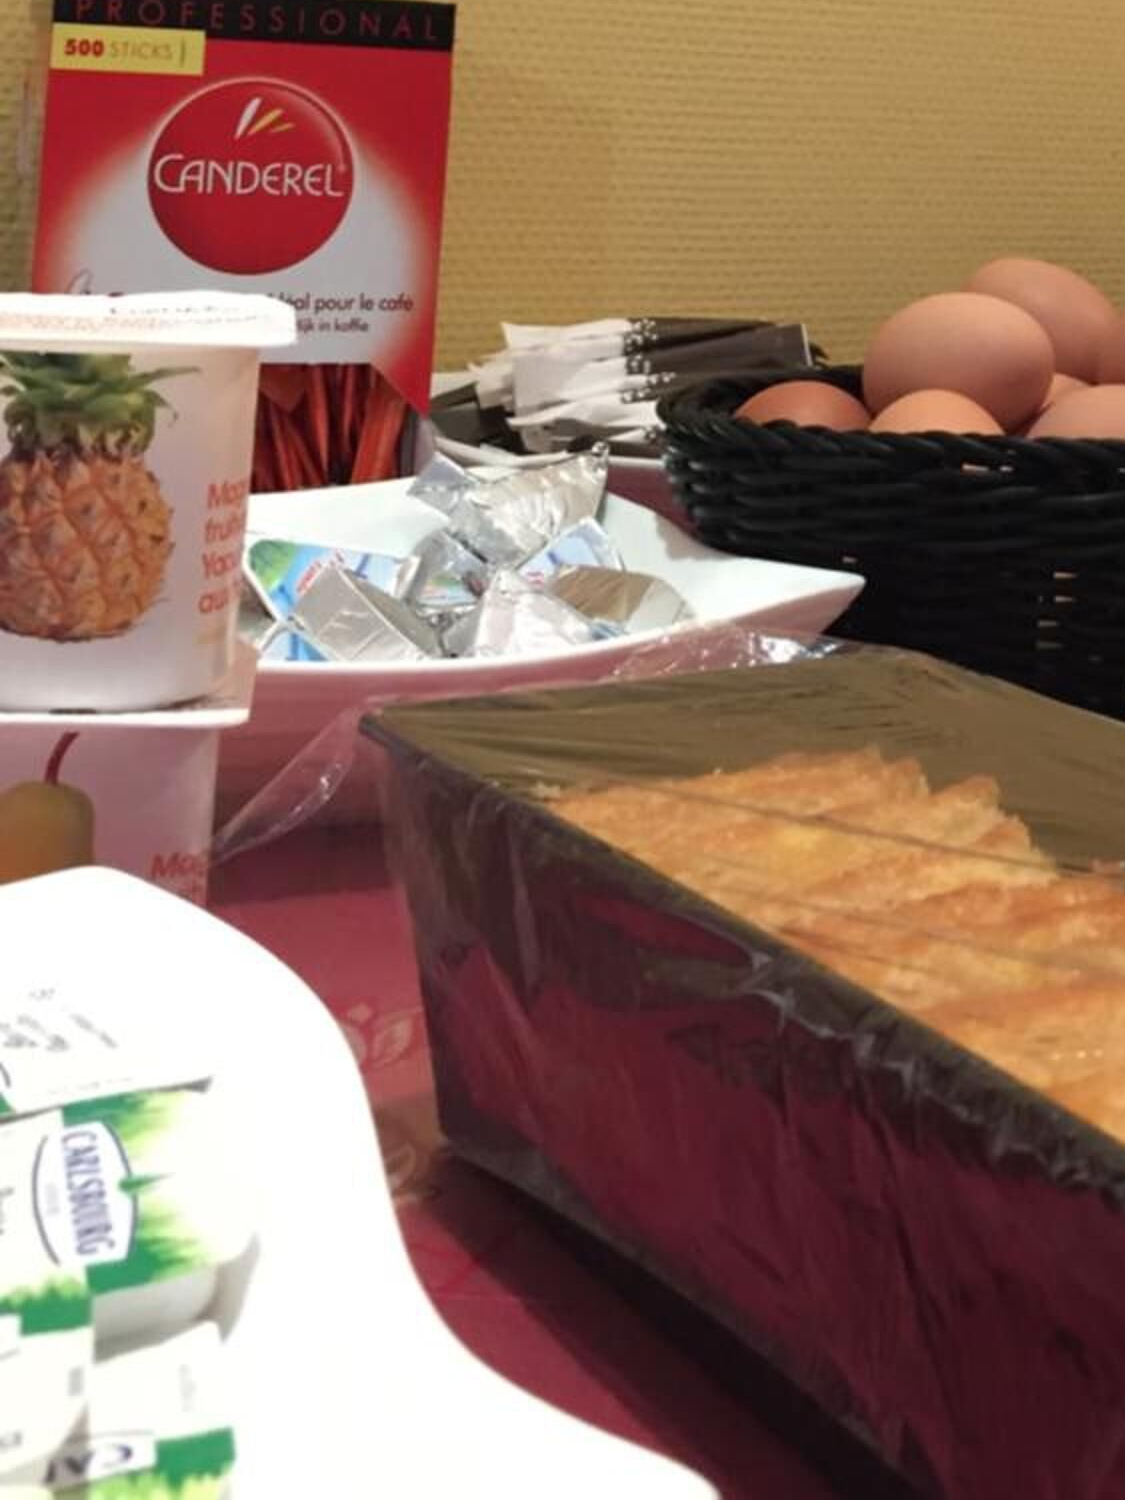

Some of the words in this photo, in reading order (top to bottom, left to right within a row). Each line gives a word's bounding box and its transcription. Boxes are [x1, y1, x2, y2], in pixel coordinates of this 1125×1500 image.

[64, 38, 105, 58] 500
[109, 40, 174, 60] STICKS
[154, 153, 344, 197] CANDEREL
[314, 297, 354, 315] pour
[360, 293, 375, 311] le
[317, 319, 331, 332] in
[335, 318, 369, 333] koffie
